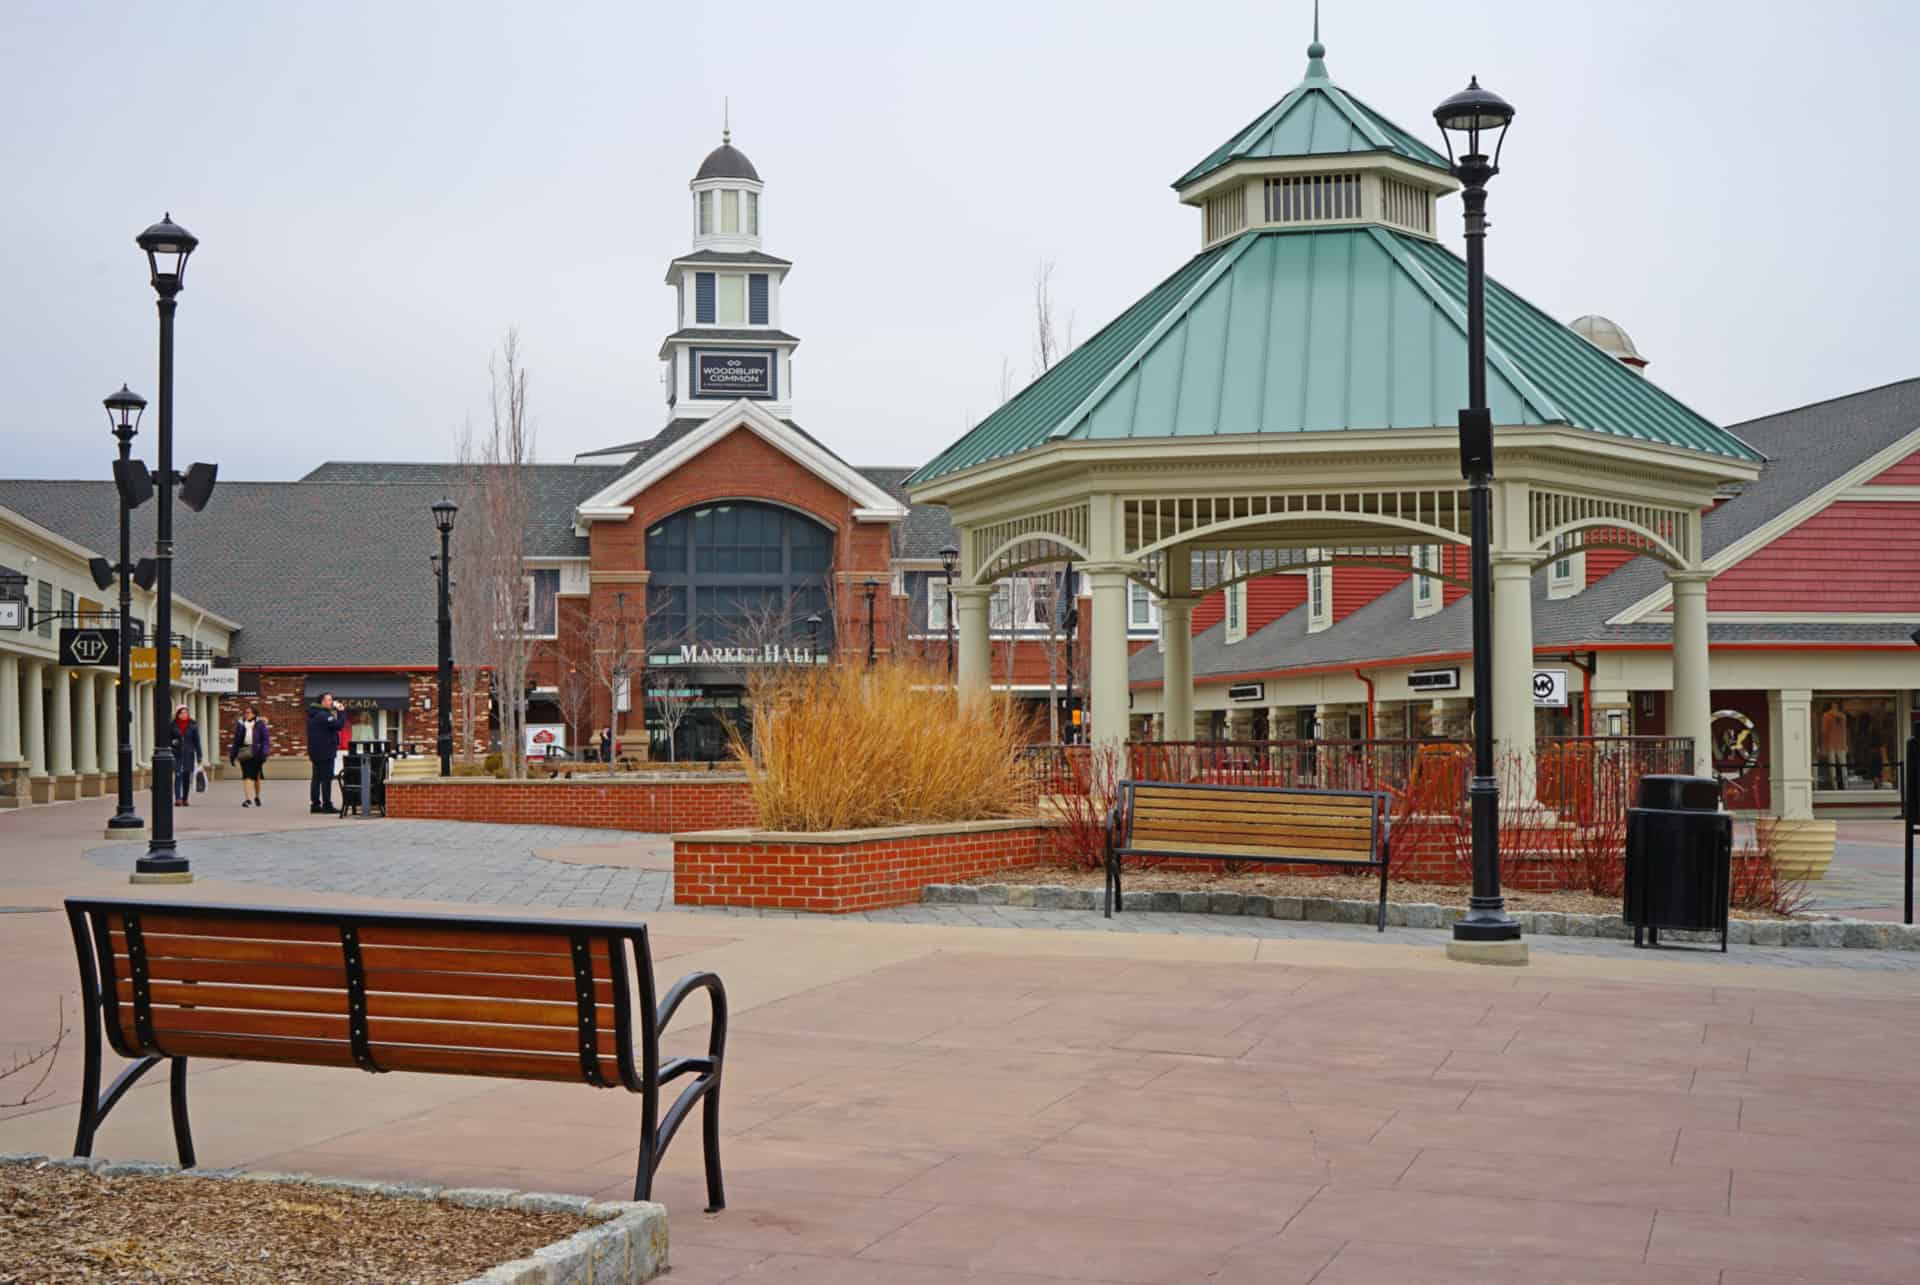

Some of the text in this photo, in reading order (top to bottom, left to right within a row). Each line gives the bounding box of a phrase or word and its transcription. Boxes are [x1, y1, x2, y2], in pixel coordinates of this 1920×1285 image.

[703, 367, 765, 375] WOODBURY
[710, 375, 759, 383] COMMON
[680, 644, 813, 663] MARKET HALL
